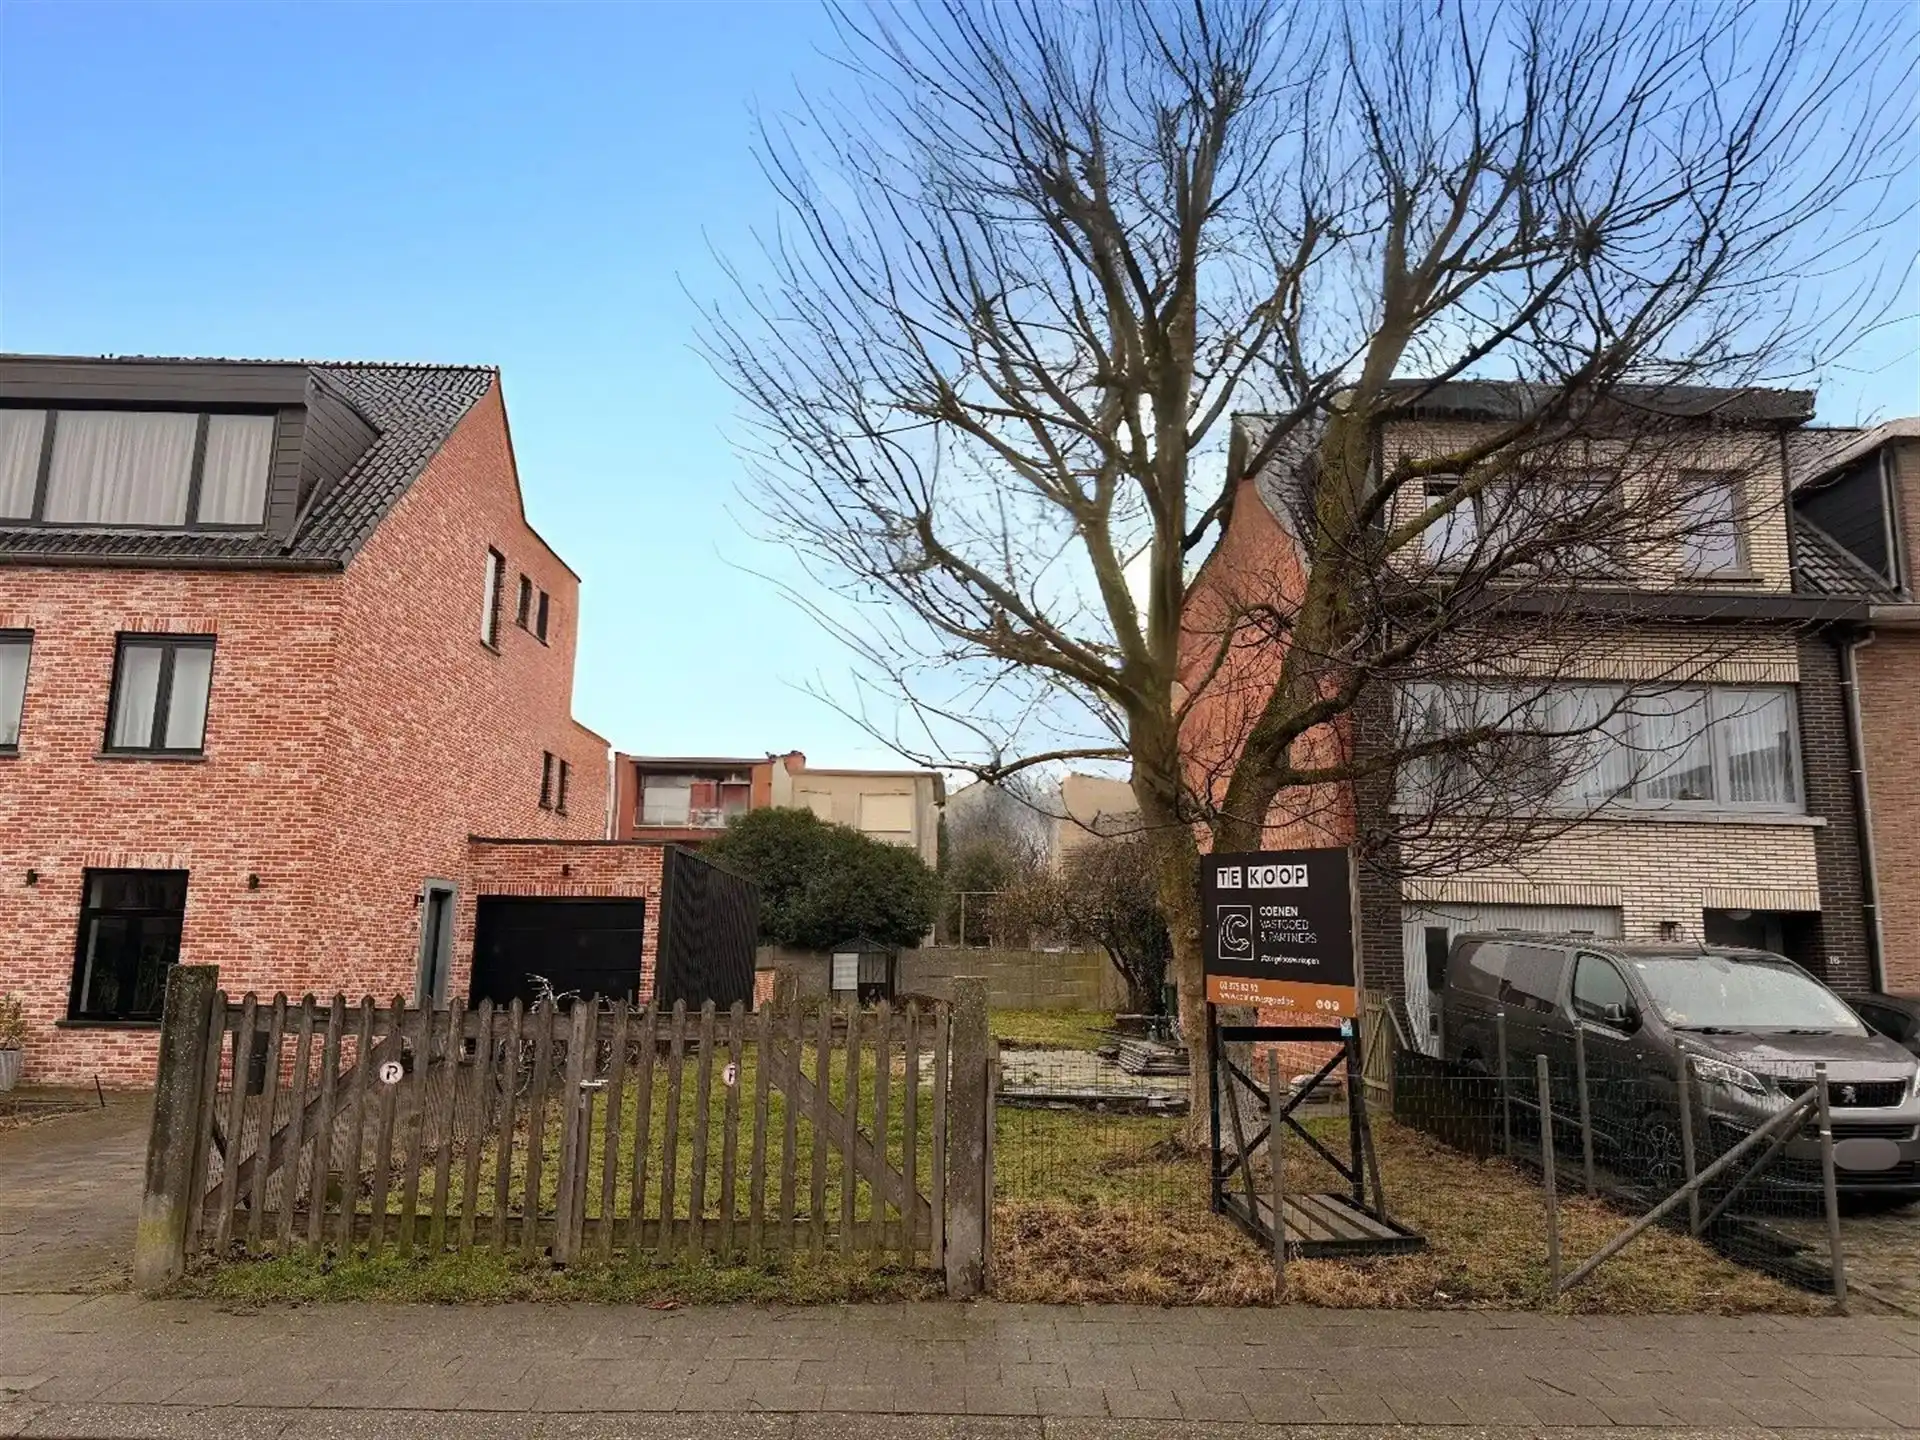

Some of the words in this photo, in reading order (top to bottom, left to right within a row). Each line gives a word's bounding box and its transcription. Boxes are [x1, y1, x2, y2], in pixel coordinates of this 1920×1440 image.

[1218, 870, 1240, 886] TE
[1250, 868, 1304, 885] KOOP
[1259, 906, 1298, 917] COENEN
[1260, 919, 1309, 931] VASTGOED
[1268, 931, 1317, 944] PARTNERS
